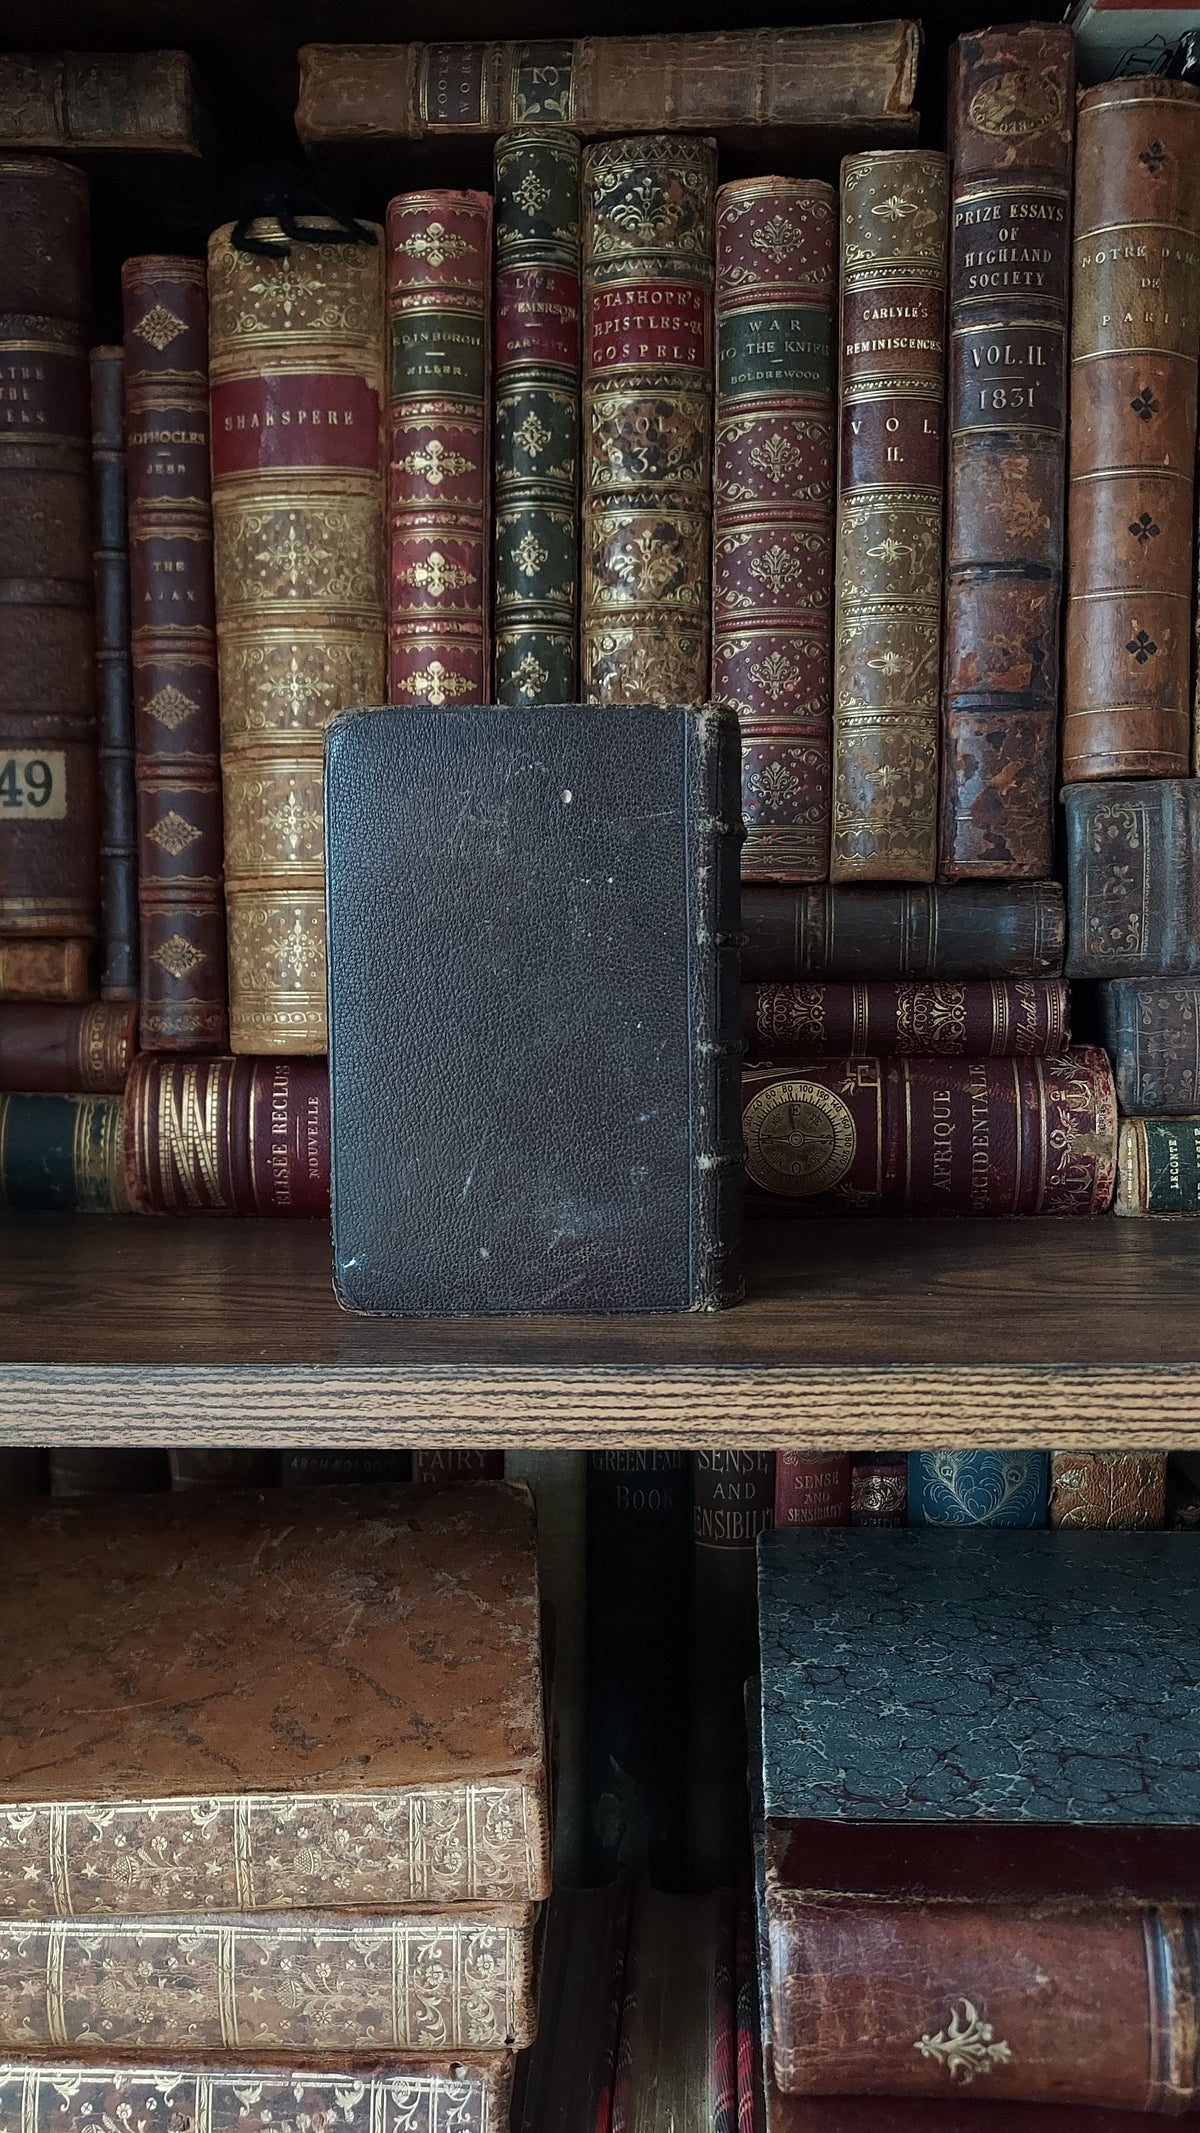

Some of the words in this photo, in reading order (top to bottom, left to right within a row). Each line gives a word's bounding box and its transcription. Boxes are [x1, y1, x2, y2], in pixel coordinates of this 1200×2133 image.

[955, 204, 1002, 228] PRIZE
[1009, 203, 1064, 222] ESSAYS
[999, 227, 1019, 242] OF
[964, 248, 1052, 268] HIGHLAND
[1081, 245, 1147, 268] NOTRE
[515, 277, 554, 291] LIFE
[968, 271, 1045, 289] SOCIETY
[1140, 277, 1160, 289] DE
[593, 290, 700, 312] STANHOPE'S
[863, 302, 928, 321] CARLYLE'S
[749, 319, 801, 333] WAR
[593, 344, 696, 362] GOSPELS
[720, 346, 737, 361] TO
[745, 341, 776, 355] THE
[784, 340, 829, 357] KNIFE
[730, 370, 820, 385] BOLDREWOOD
[978, 387, 1035, 410] 1831
[224, 410, 354, 432] SHAKSPERE
[614, 416, 678, 435] VOL.
[128, 430, 205, 447] SOPHOCLES
[886, 446, 904, 462] II.
[153, 561, 185, 572] THE
[144, 590, 195, 602] AJAX
[0, 759, 54, 808] 49
[764, 1089, 777, 1101] 60
[781, 1084, 793, 1093] 80
[798, 1084, 814, 1094] 100
[816, 1089, 830, 1101] 120
[271, 1064, 291, 1136] RECLUS
[752, 1099, 763, 1112] 40
[830, 1099, 842, 1113] 140
[840, 1115, 852, 1130] 160
[307, 1096, 320, 1179] NOUVELLE
[843, 1133, 853, 1148] 180
[932, 1090, 956, 1193] AFRIQUE
[968, 1064, 989, 1210] OCCIDENTALE
[1168, 1139, 1180, 1189] LECONTE
[266, 1143, 292, 1205] ÉLISÉE
[697, 1450, 769, 1475] SENSE
[794, 1471, 839, 1490] SENSE
[712, 1482, 756, 1500] AND
[804, 1492, 831, 1505] AND
